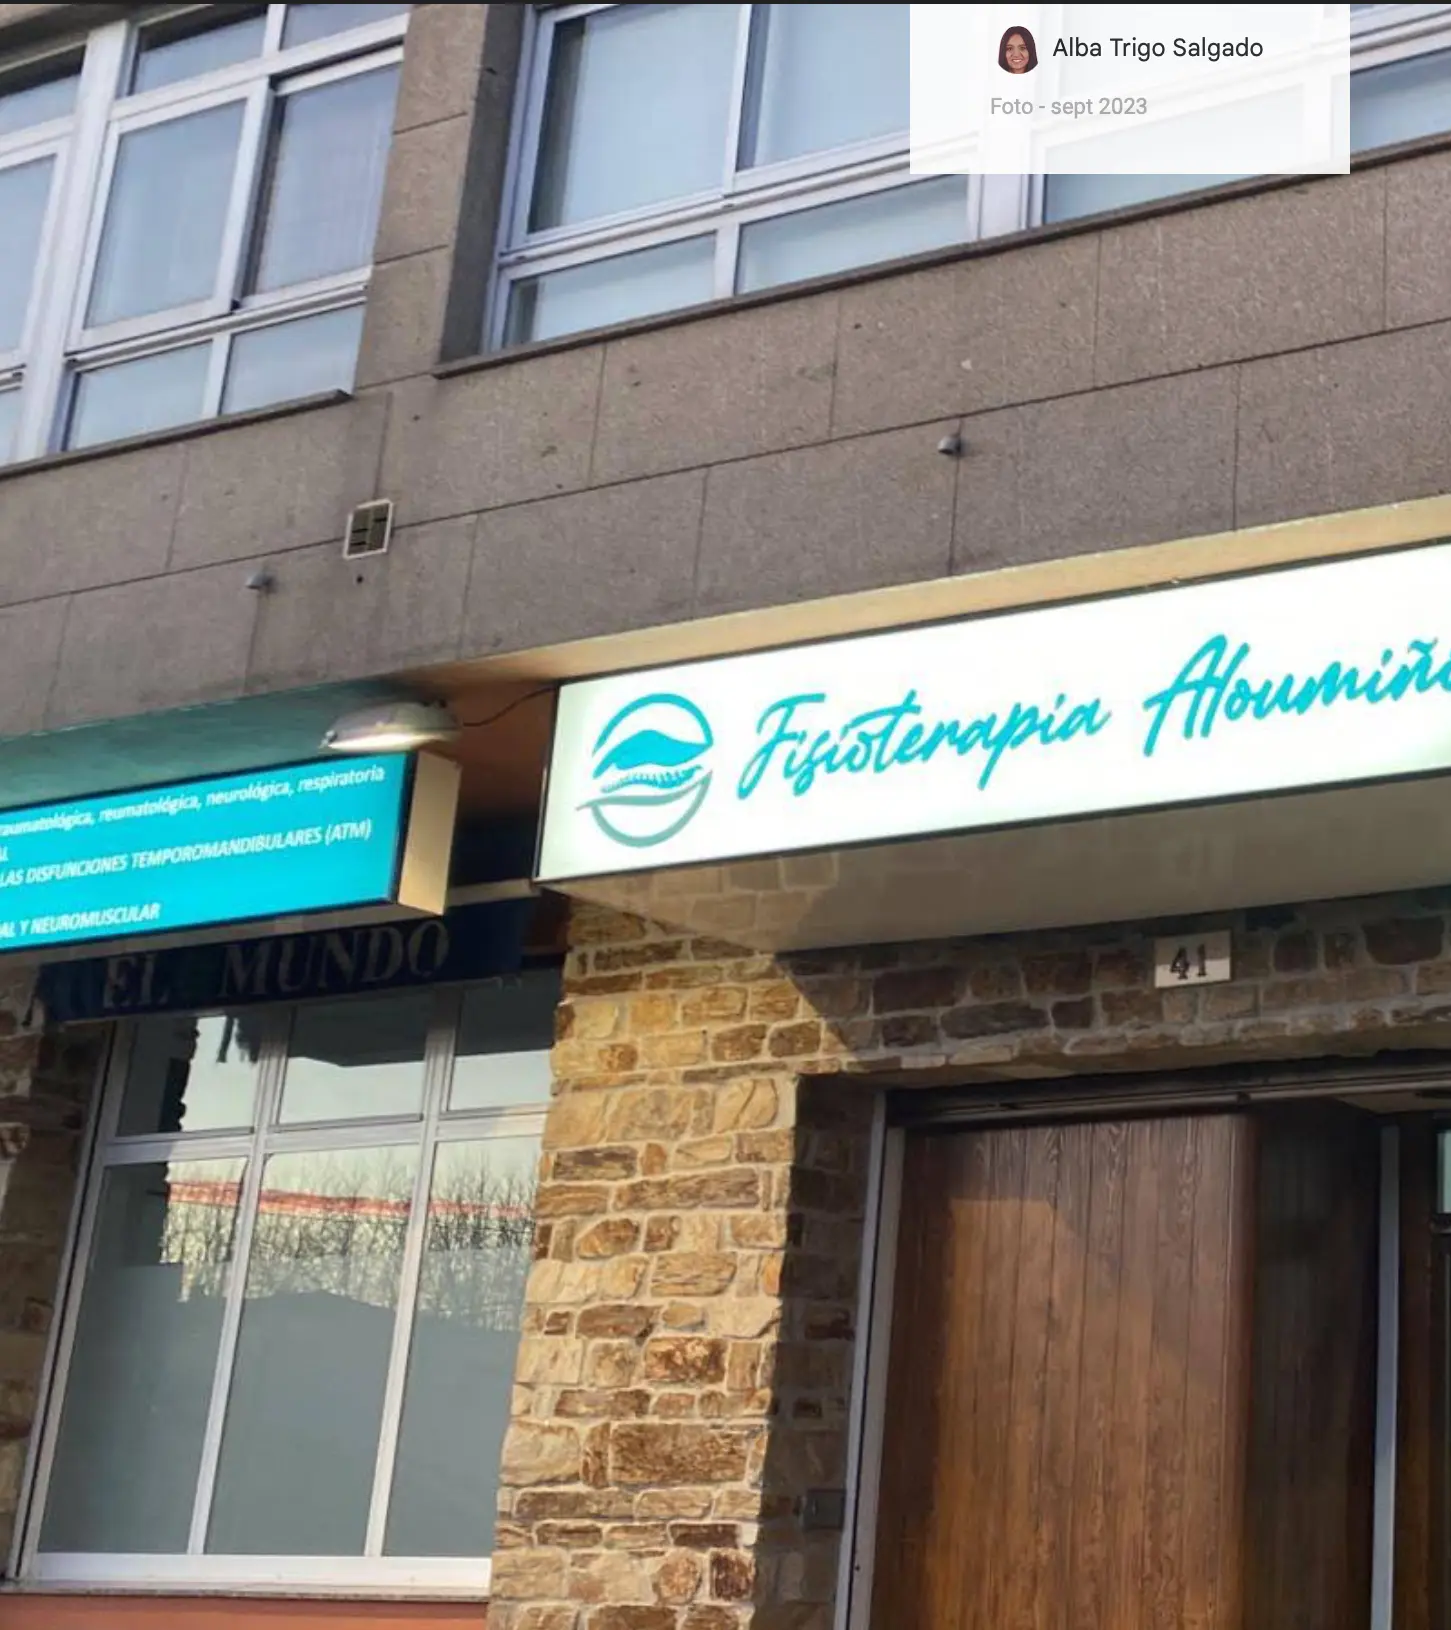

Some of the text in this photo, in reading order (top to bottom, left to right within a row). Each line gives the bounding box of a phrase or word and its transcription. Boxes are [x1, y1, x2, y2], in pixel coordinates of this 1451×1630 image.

[736, 688, 1111, 800] Fisioterapia
[100, 795, 202, 823] reumatológica,
[206, 779, 294, 808] neurológica,
[298, 764, 385, 793] respiratoria
[26, 853, 129, 884] DISFUNCIONES
[132, 826, 322, 868] TEMPOROMANDIBULARES
[326, 818, 372, 847] (ATM)
[20, 918, 30, 935] Y
[31, 902, 161, 934] NEUROMUSCULAR
[102, 920, 450, 1009] EL MUNDO
[1171, 944, 1206, 980] 41
